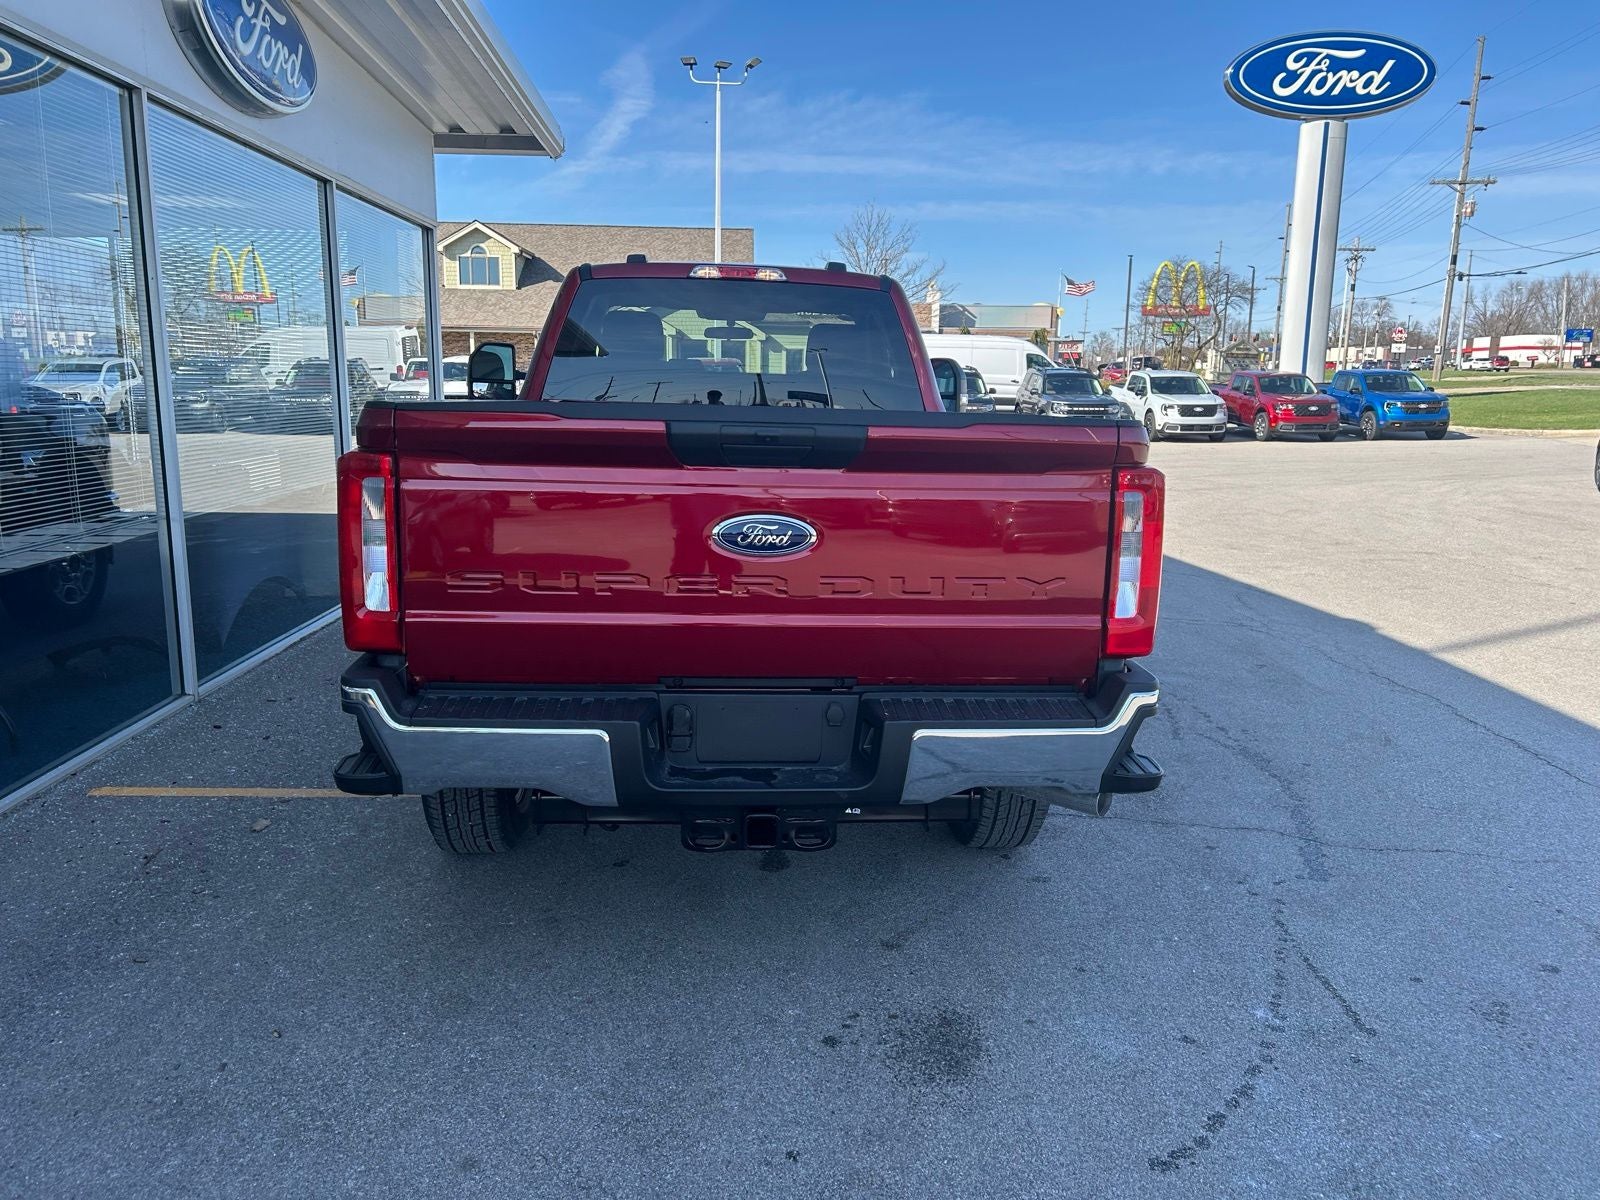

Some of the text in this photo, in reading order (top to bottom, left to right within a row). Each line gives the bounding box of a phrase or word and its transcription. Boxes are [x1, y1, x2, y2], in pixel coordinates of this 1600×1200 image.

[235, 0, 303, 89] Ford
[1272, 47, 1396, 97] Ford
[737, 523, 793, 546] Ford
[445, 571, 1067, 599] SUPER DUTY
